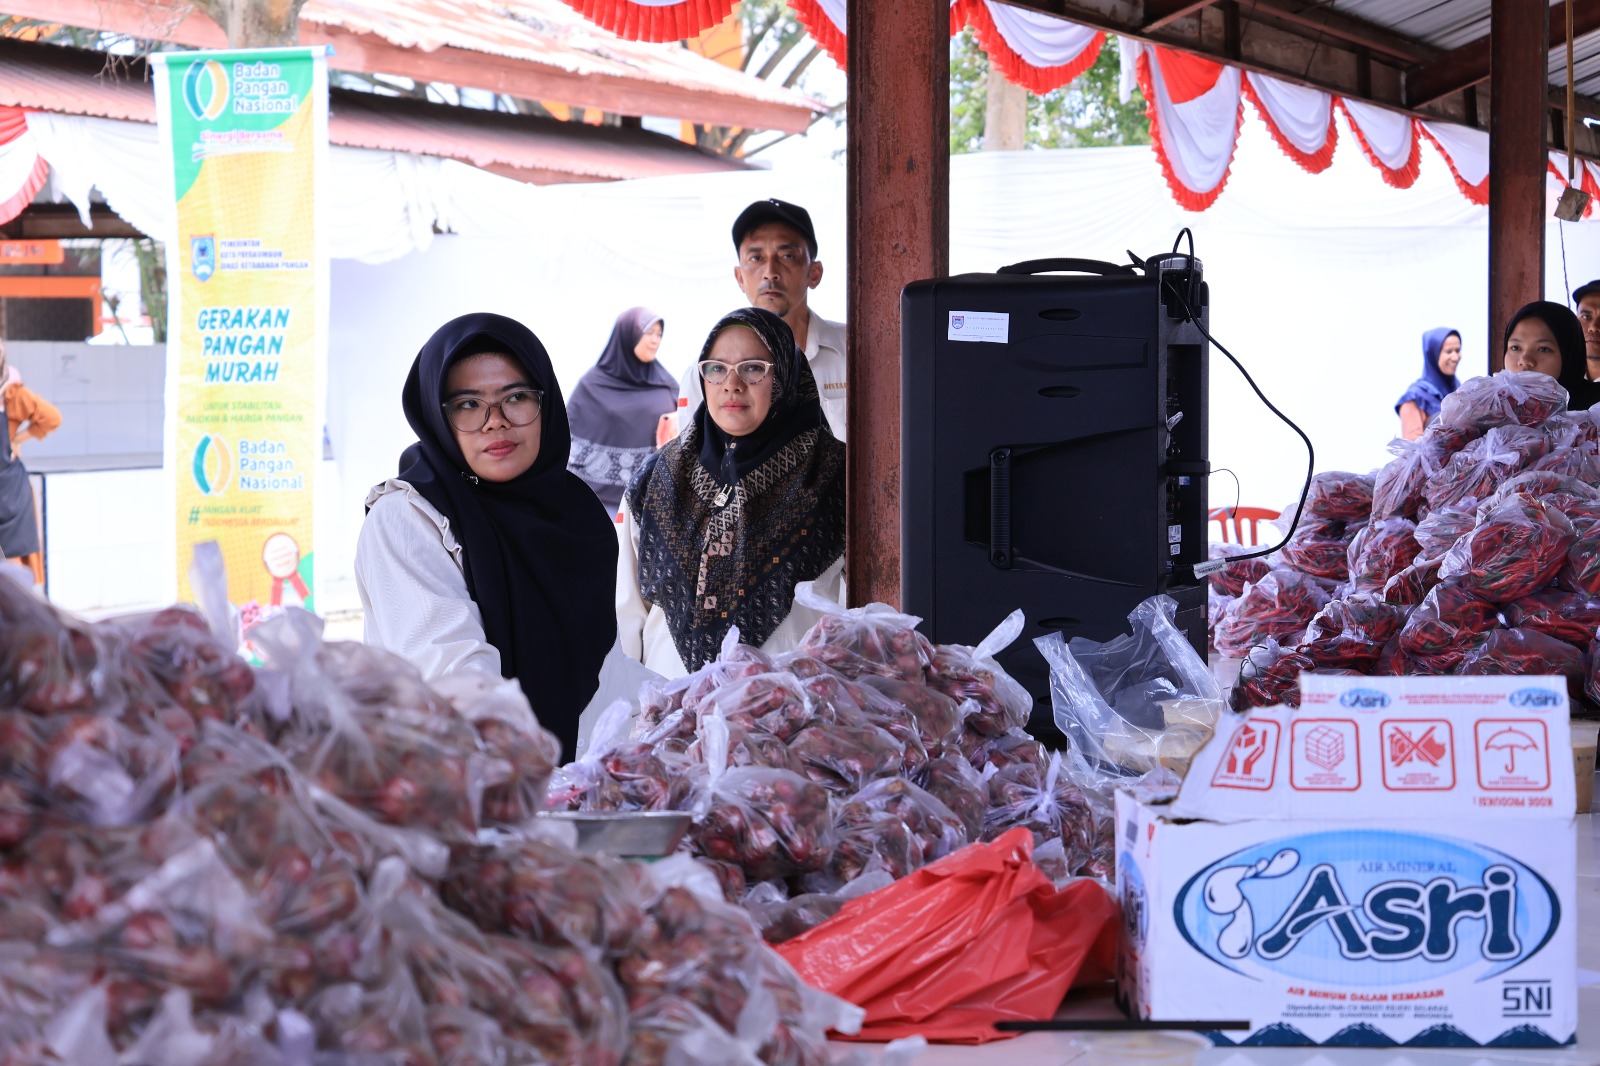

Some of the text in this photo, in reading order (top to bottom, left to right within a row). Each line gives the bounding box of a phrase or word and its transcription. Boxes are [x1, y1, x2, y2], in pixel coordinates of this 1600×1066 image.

[234, 61, 279, 78] Badan
[234, 81, 287, 95] Pangan
[234, 96, 297, 112] Nasional
[197, 308, 290, 330] GERAKAN
[203, 335, 284, 356] PANGAN
[205, 362, 279, 383] MURAH
[231, 414, 263, 423] HARGA
[265, 413, 303, 422] PANGAN
[240, 439, 285, 454] Badan
[240, 458, 293, 473] Pangan
[240, 475, 302, 489] Nasional
[1358, 861, 1457, 873] AIR MINERAL
[1256, 863, 1523, 961] Asri
[1287, 986, 1445, 1001] AIR MINUM DALAM KEMASAN
[1503, 986, 1551, 1010] SNI
